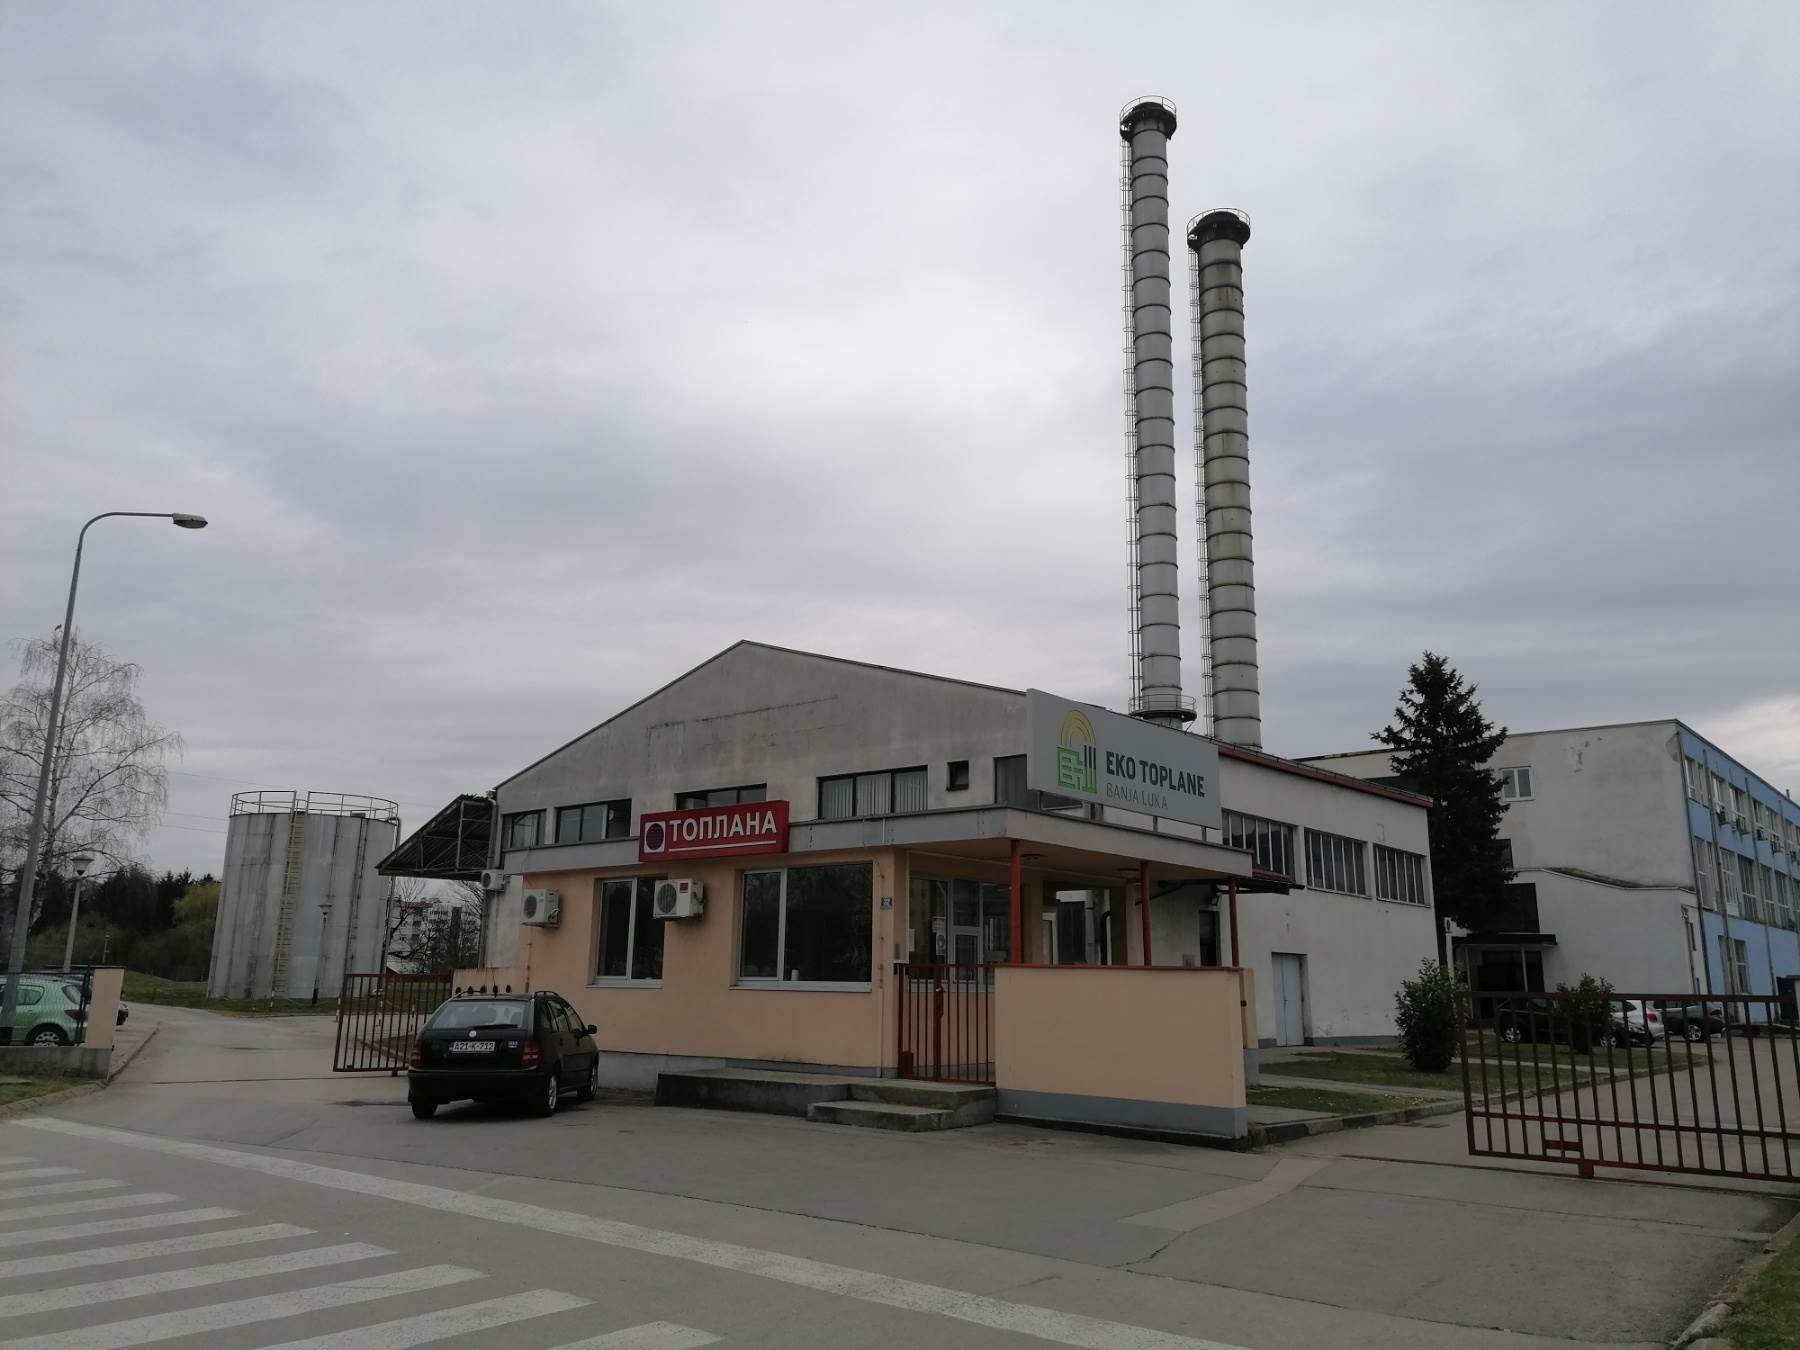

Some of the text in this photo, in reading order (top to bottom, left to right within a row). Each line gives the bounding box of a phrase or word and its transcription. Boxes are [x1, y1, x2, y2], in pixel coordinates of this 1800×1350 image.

[1106, 751, 1205, 798] EKO TOPLANE
[1106, 782, 1168, 810] BANJA LUKA
[669, 810, 777, 842] ТОПЛАНА
